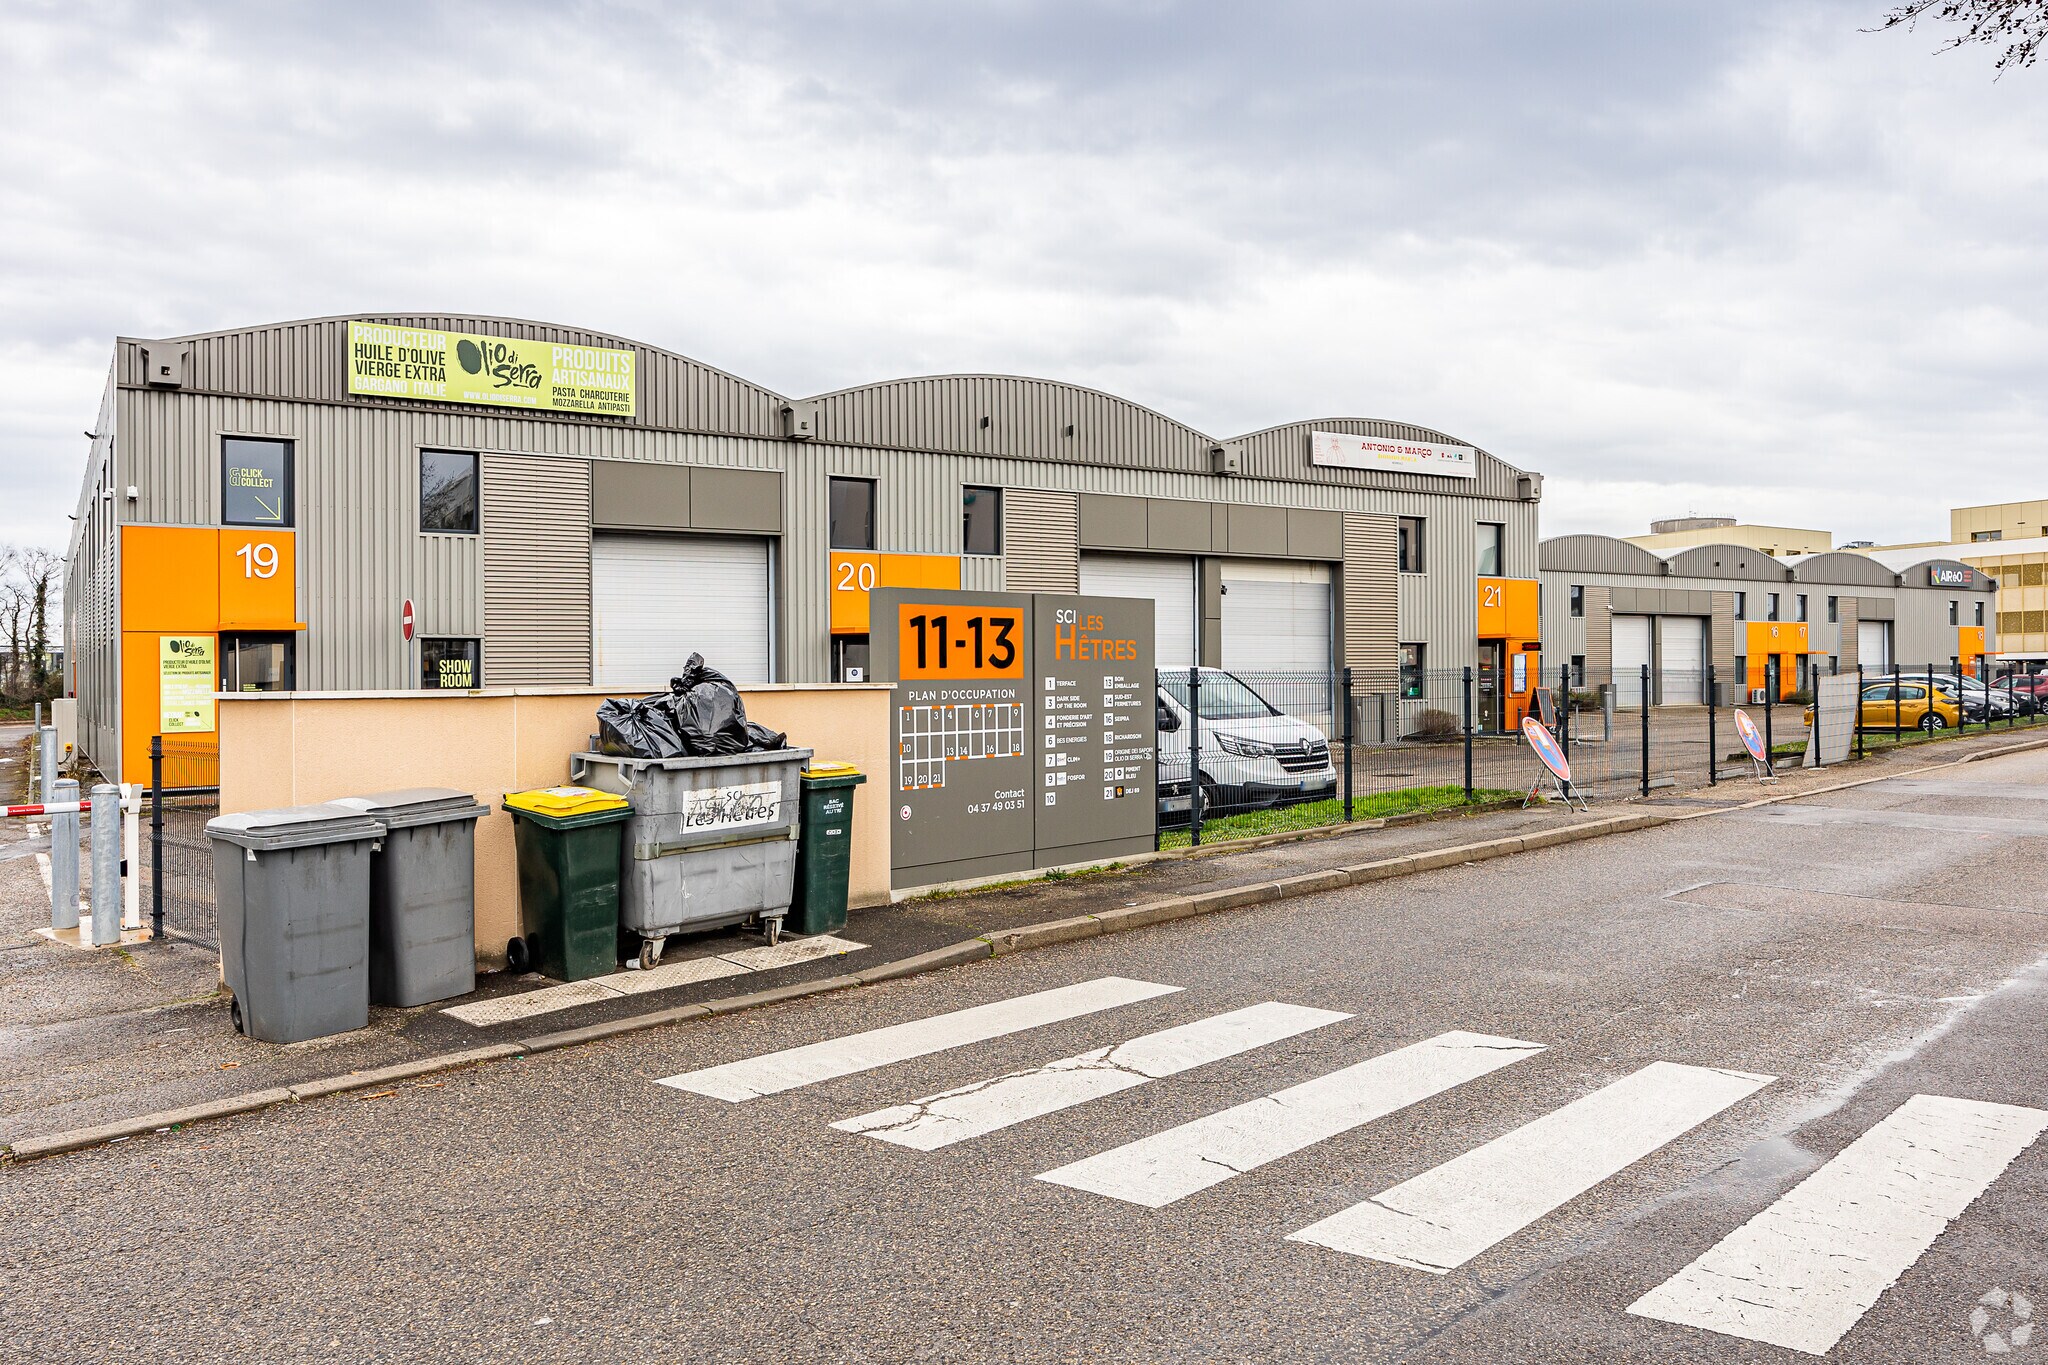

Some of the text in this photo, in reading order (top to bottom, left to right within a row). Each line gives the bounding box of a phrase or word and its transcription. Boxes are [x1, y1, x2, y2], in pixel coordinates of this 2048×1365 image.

[354, 325, 446, 350] PRODUCTEUR
[354, 343, 446, 366] HUILE D'OLIVE
[456, 339, 518, 376] Olio di
[552, 346, 630, 374] PRODUITS
[355, 360, 446, 382] VIERGE EXTRA
[492, 364, 542, 389] Serra
[552, 368, 630, 391] ARTISANAUX
[354, 377, 447, 397] GARGANO ITALIE
[552, 386, 630, 402] PASTA CHARCUTERIE
[552, 398, 630, 412] MOZZARELLA ANTIPASTI
[1361, 442, 1395, 453] ANTONIO
[1405, 446, 1432, 459] MARCO
[241, 468, 263, 478] CLICK
[241, 477, 273, 488] COLLECT
[236, 543, 279, 579] 19
[837, 562, 875, 592] 20
[1483, 585, 1501, 607] 21
[1056, 608, 1104, 631] SCI LES
[1770, 626, 1779, 638] 16
[1799, 626, 1806, 638] 17
[1977, 630, 1983, 641] 18
[909, 615, 1016, 669] 11-13
[1055, 624, 1137, 660] HÊTRES
[439, 659, 472, 673] SHOW
[440, 673, 472, 688] ROOM
[1105, 679, 1112, 687] 13
[908, 689, 1016, 701] PLAN D'OCCUPATION
[1105, 697, 1112, 705] 14
[1048, 699, 1053, 707] 3
[906, 708, 1019, 721] 1 3 4 6 7 9
[1048, 737, 1053, 745] 6
[902, 743, 1020, 756] 10 13 14 16 18
[1105, 752, 1112, 760] 19
[1048, 756, 1053, 765] 7
[904, 773, 941, 785] 19 20 21
[1048, 775, 1053, 783] 9
[1104, 771, 1113, 779] 20
[994, 788, 1025, 799] Contact
[1047, 795, 1054, 803] 10
[1106, 789, 1112, 797] 21
[967, 800, 1025, 814] 04 37 49 03 51
